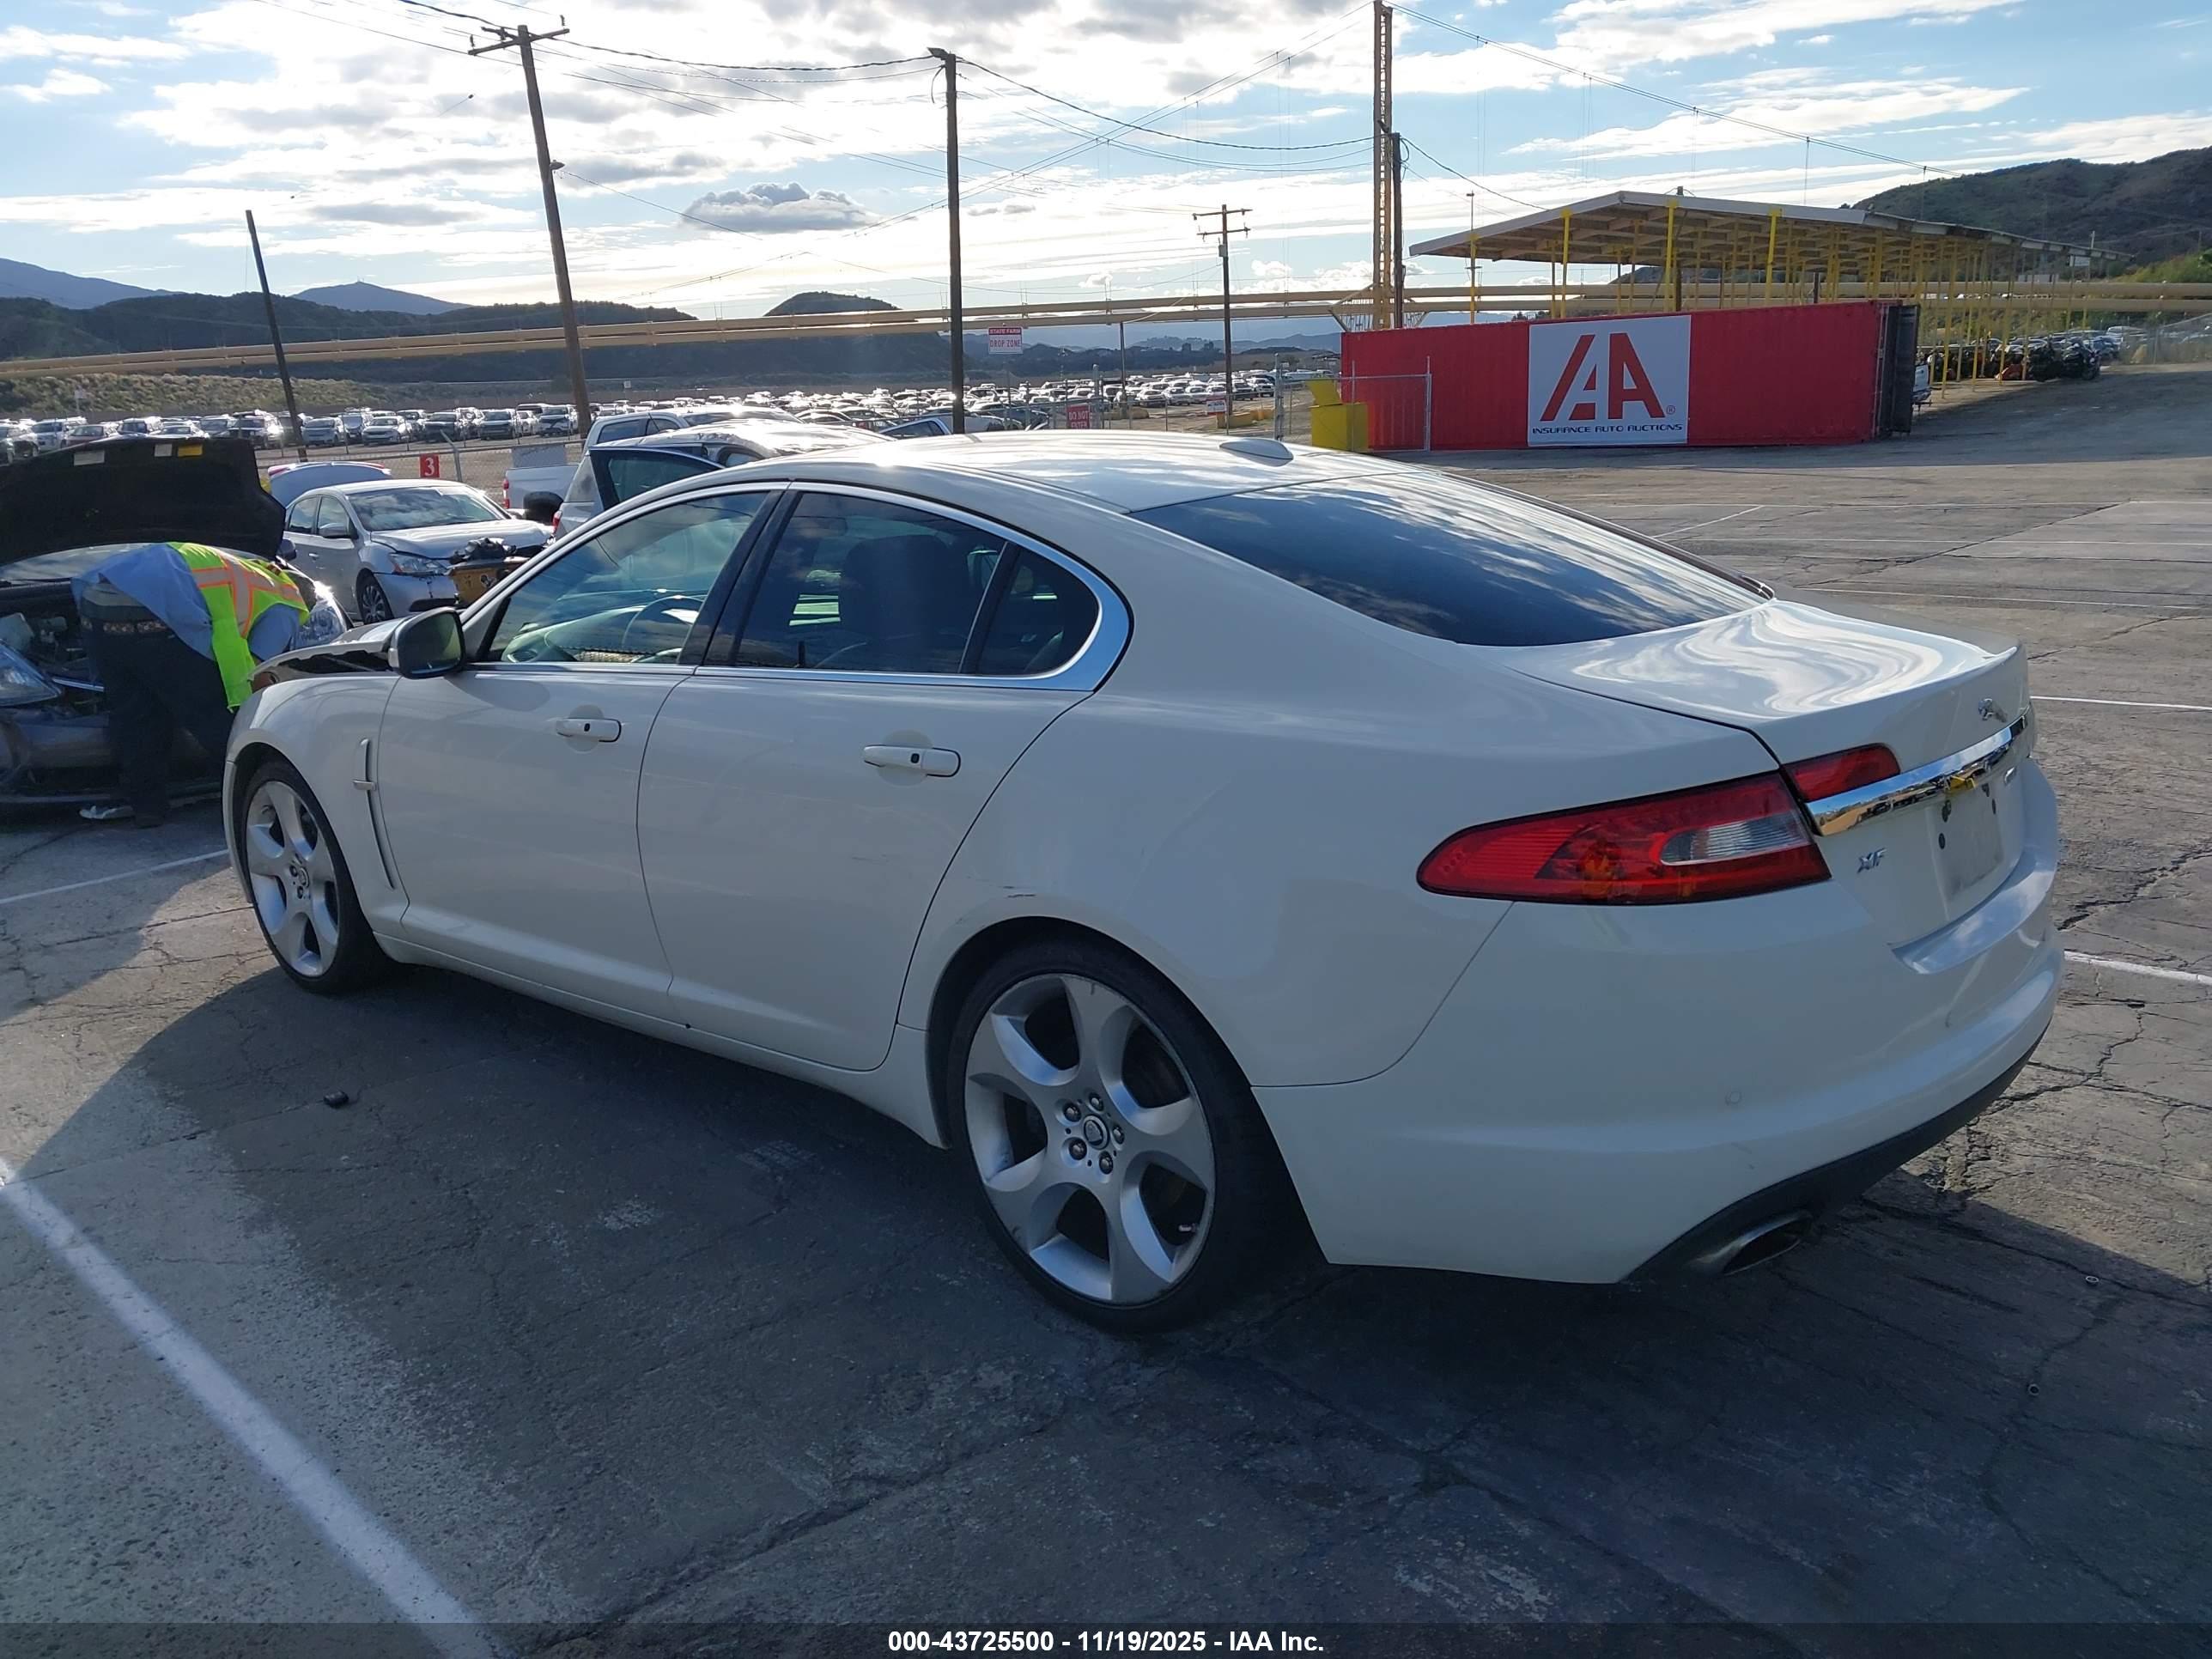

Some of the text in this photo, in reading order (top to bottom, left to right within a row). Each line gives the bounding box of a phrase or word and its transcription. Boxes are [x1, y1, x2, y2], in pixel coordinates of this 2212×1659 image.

[989, 339, 1020, 348] DROP ZONE
[1068, 410, 1089, 420] DO NOT
[1532, 423, 1683, 434] INSURANCE AUTO AUCTIONS
[423, 457, 434, 477] 3
[1857, 848, 1887, 873] XF
